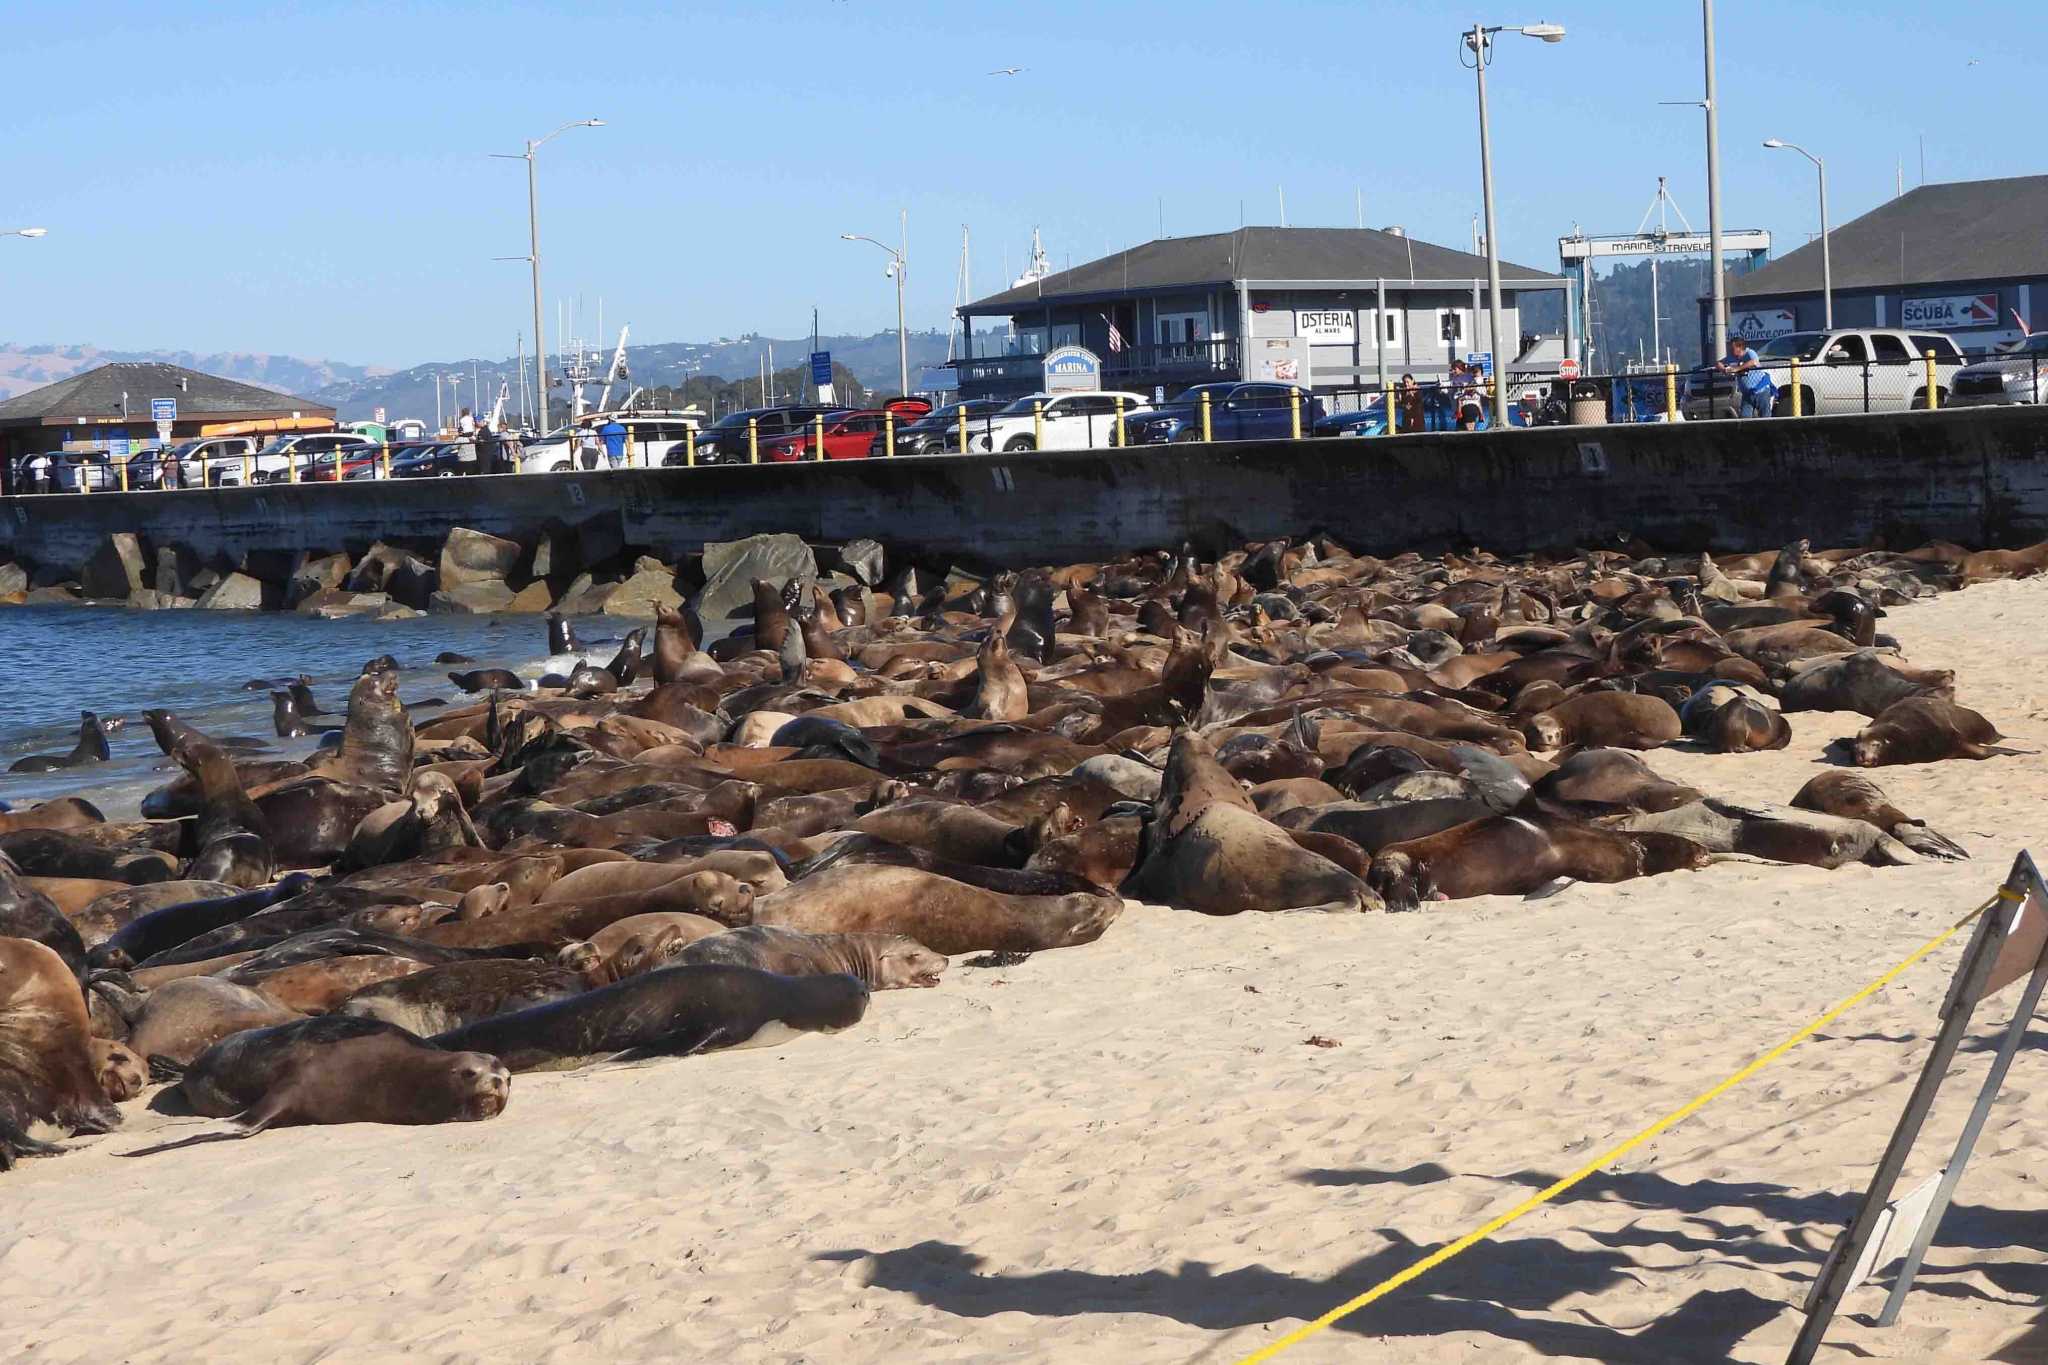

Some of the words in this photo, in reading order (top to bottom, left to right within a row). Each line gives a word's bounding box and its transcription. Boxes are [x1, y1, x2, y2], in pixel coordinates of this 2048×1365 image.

[1904, 305, 1954, 320] SCUBA
[1302, 312, 1353, 329] OSTERIA
[1055, 362, 1089, 373] MARINA
[1560, 366, 1578, 376] STOP
